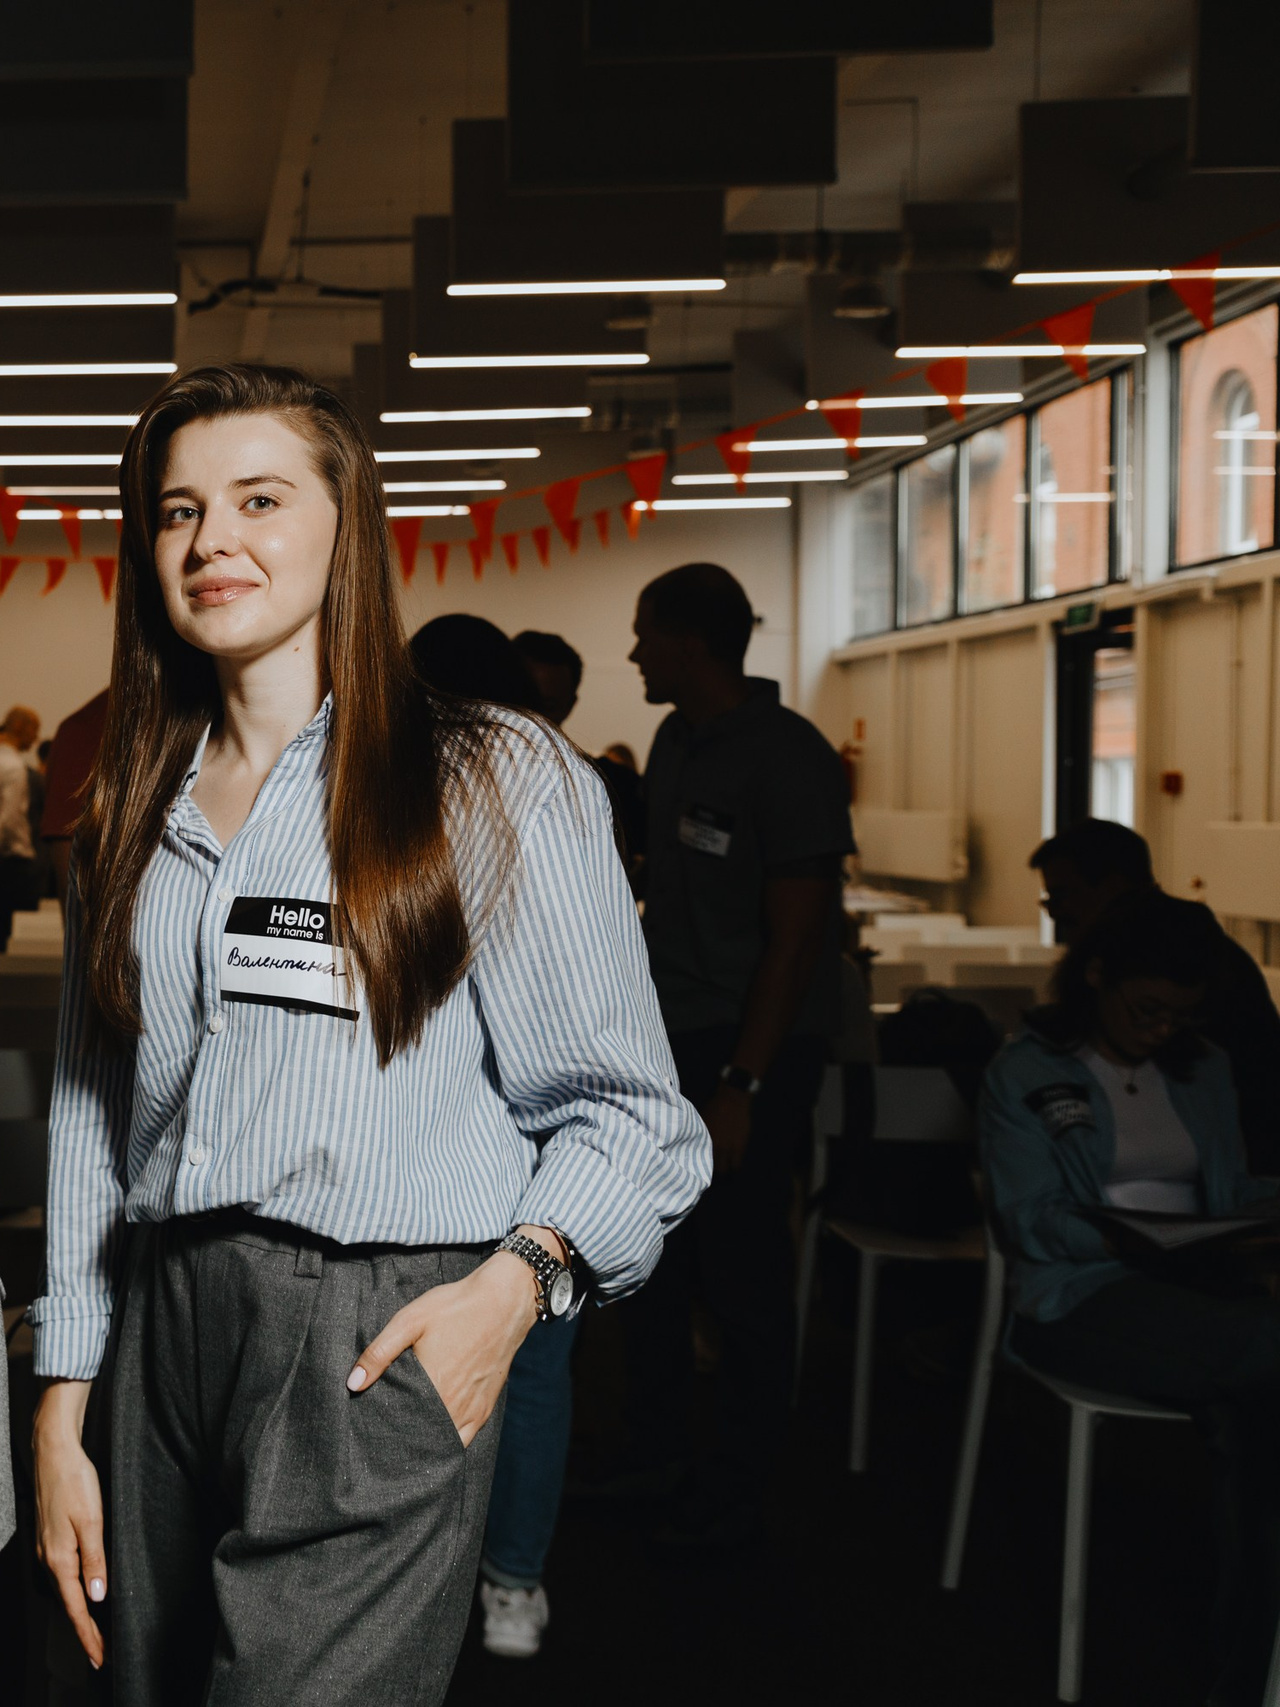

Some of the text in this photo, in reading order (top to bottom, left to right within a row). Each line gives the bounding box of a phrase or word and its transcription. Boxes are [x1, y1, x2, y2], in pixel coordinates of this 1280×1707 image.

[270, 905, 325, 929] Hello
[266, 926, 324, 941] my name is
[227, 946, 348, 977] Валентина
